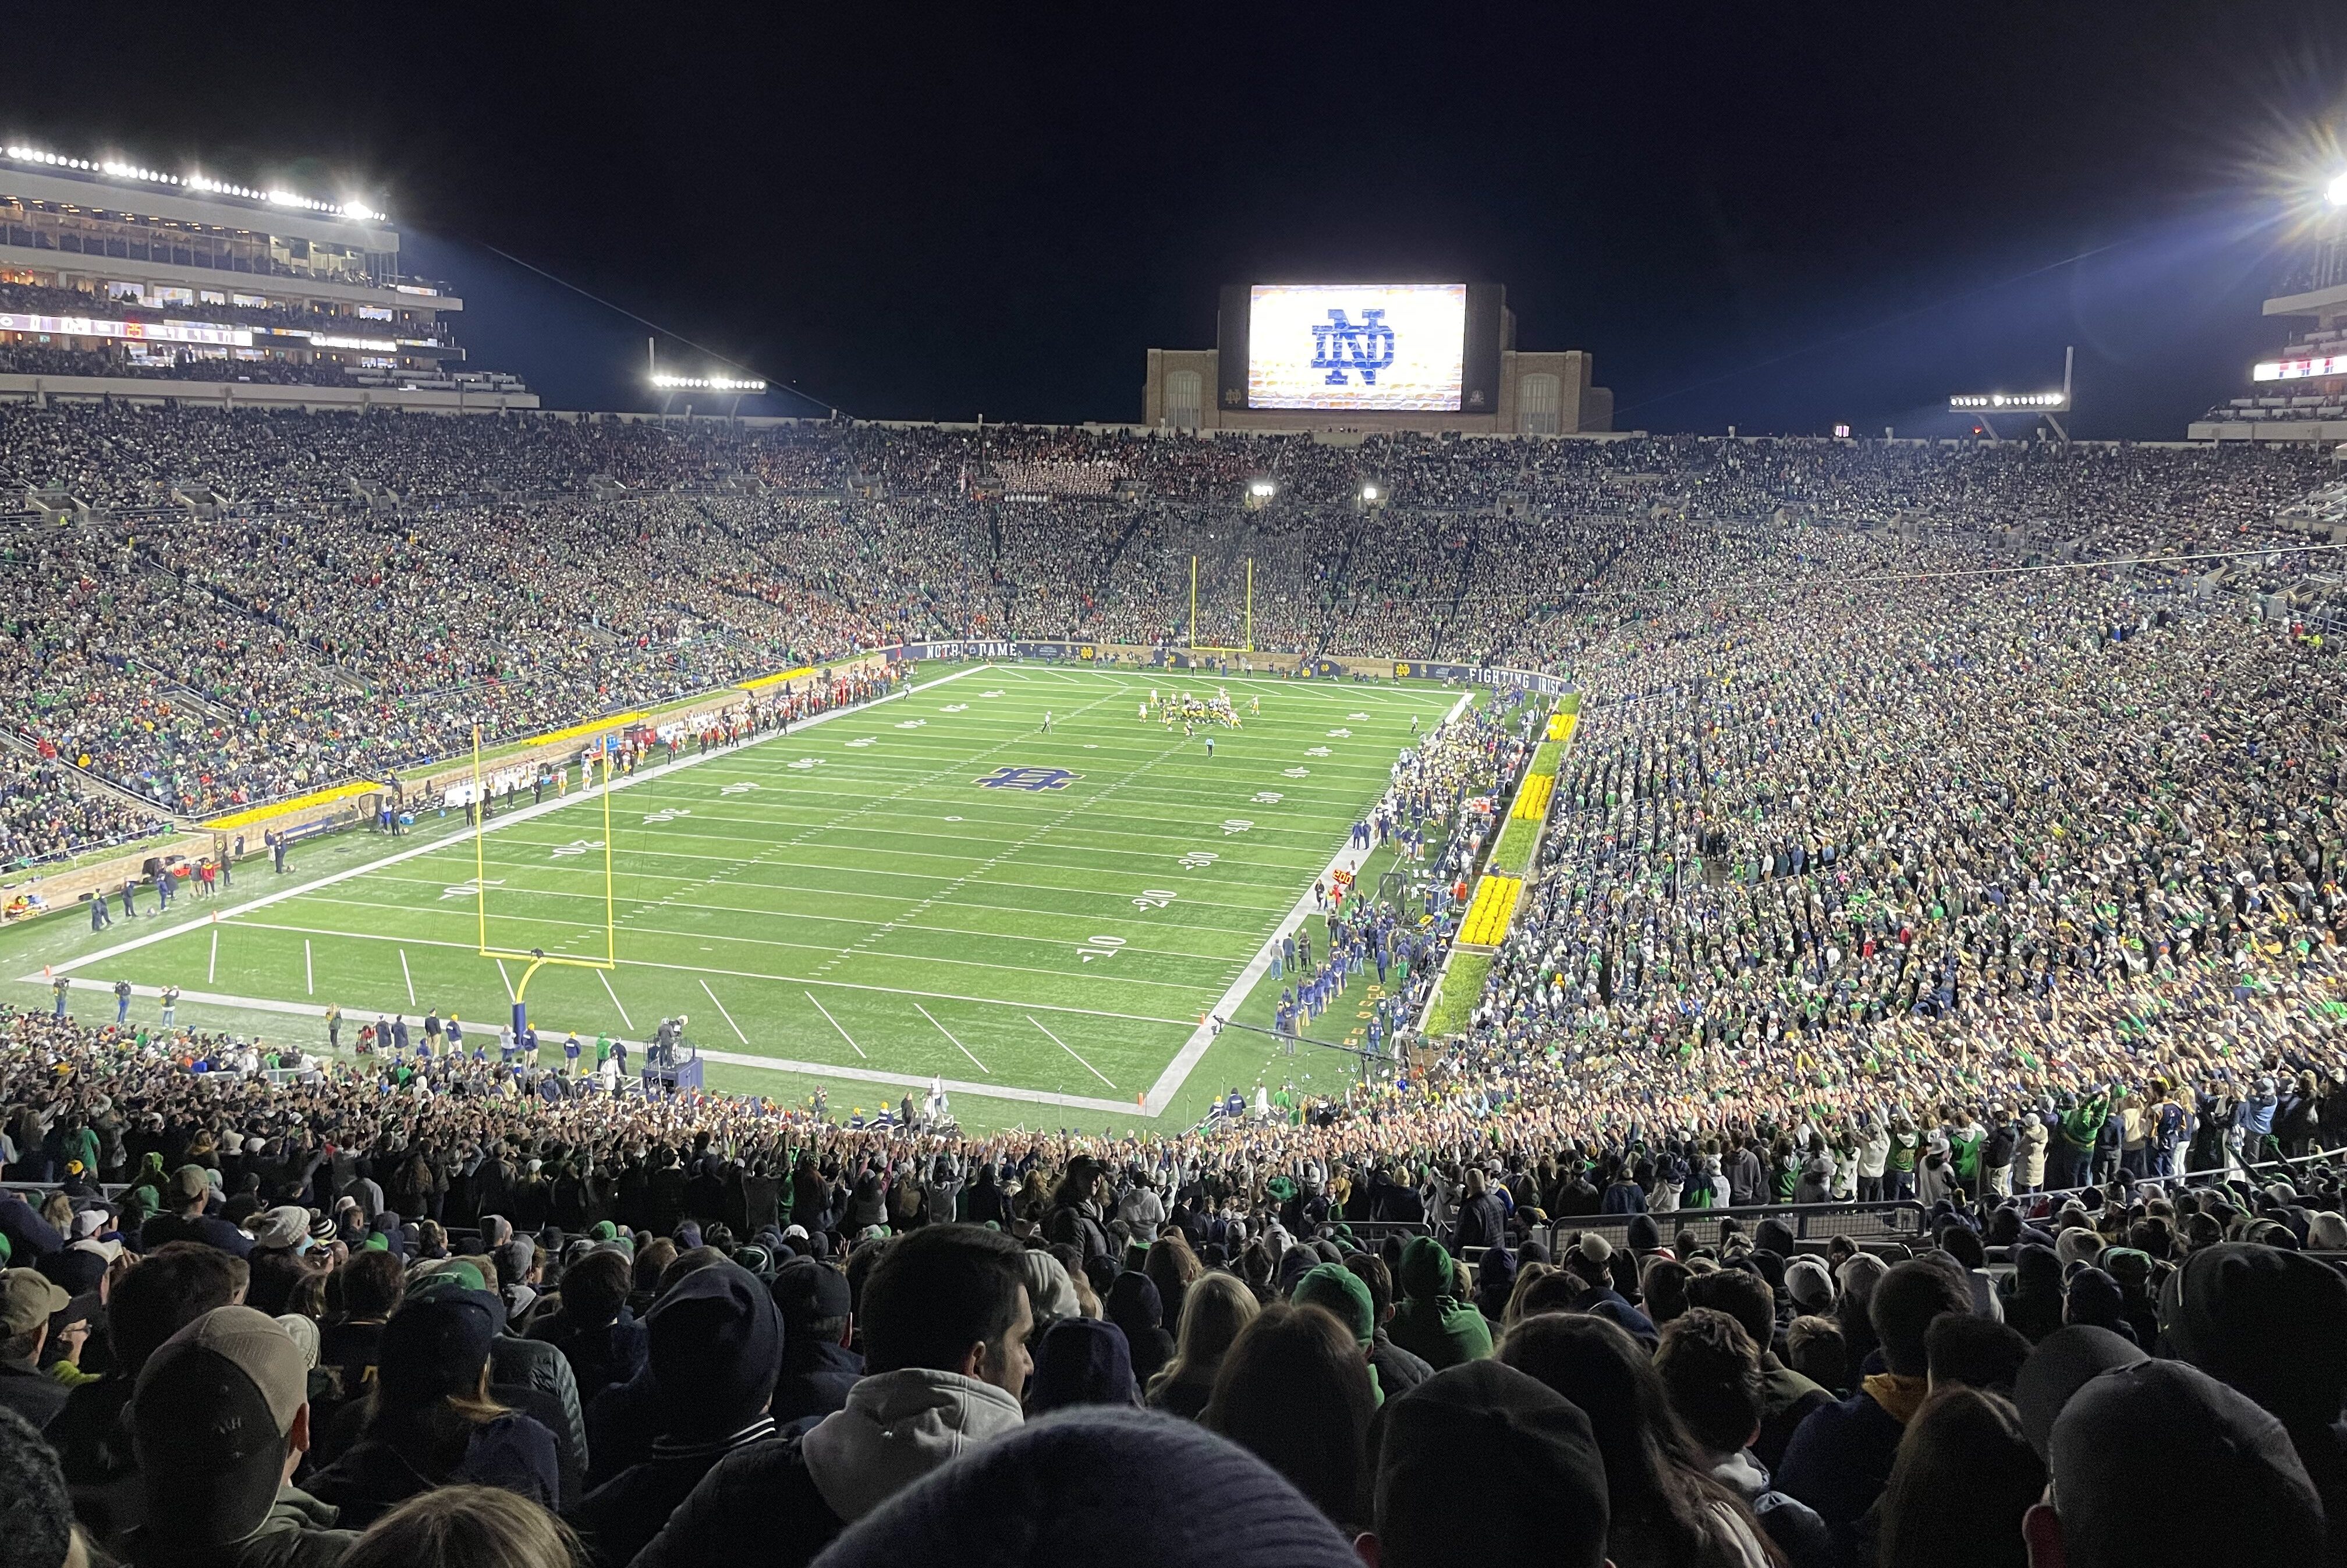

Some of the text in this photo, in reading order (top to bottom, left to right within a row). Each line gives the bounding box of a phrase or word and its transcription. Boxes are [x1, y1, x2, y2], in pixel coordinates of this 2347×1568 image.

[926, 643, 1017, 659] NOTR DAME
[1469, 668, 1529, 689] FIGHTING
[1249, 792, 1284, 804] 50
[643, 808, 692, 821] 30
[1218, 820, 1255, 832] 40
[552, 839, 607, 854] 20
[1178, 852, 1219, 867] 30
[1332, 870, 1353, 885] 200
[444, 878, 507, 895] 10
[1132, 889, 1178, 908] 20
[1076, 936, 1127, 957] 10
